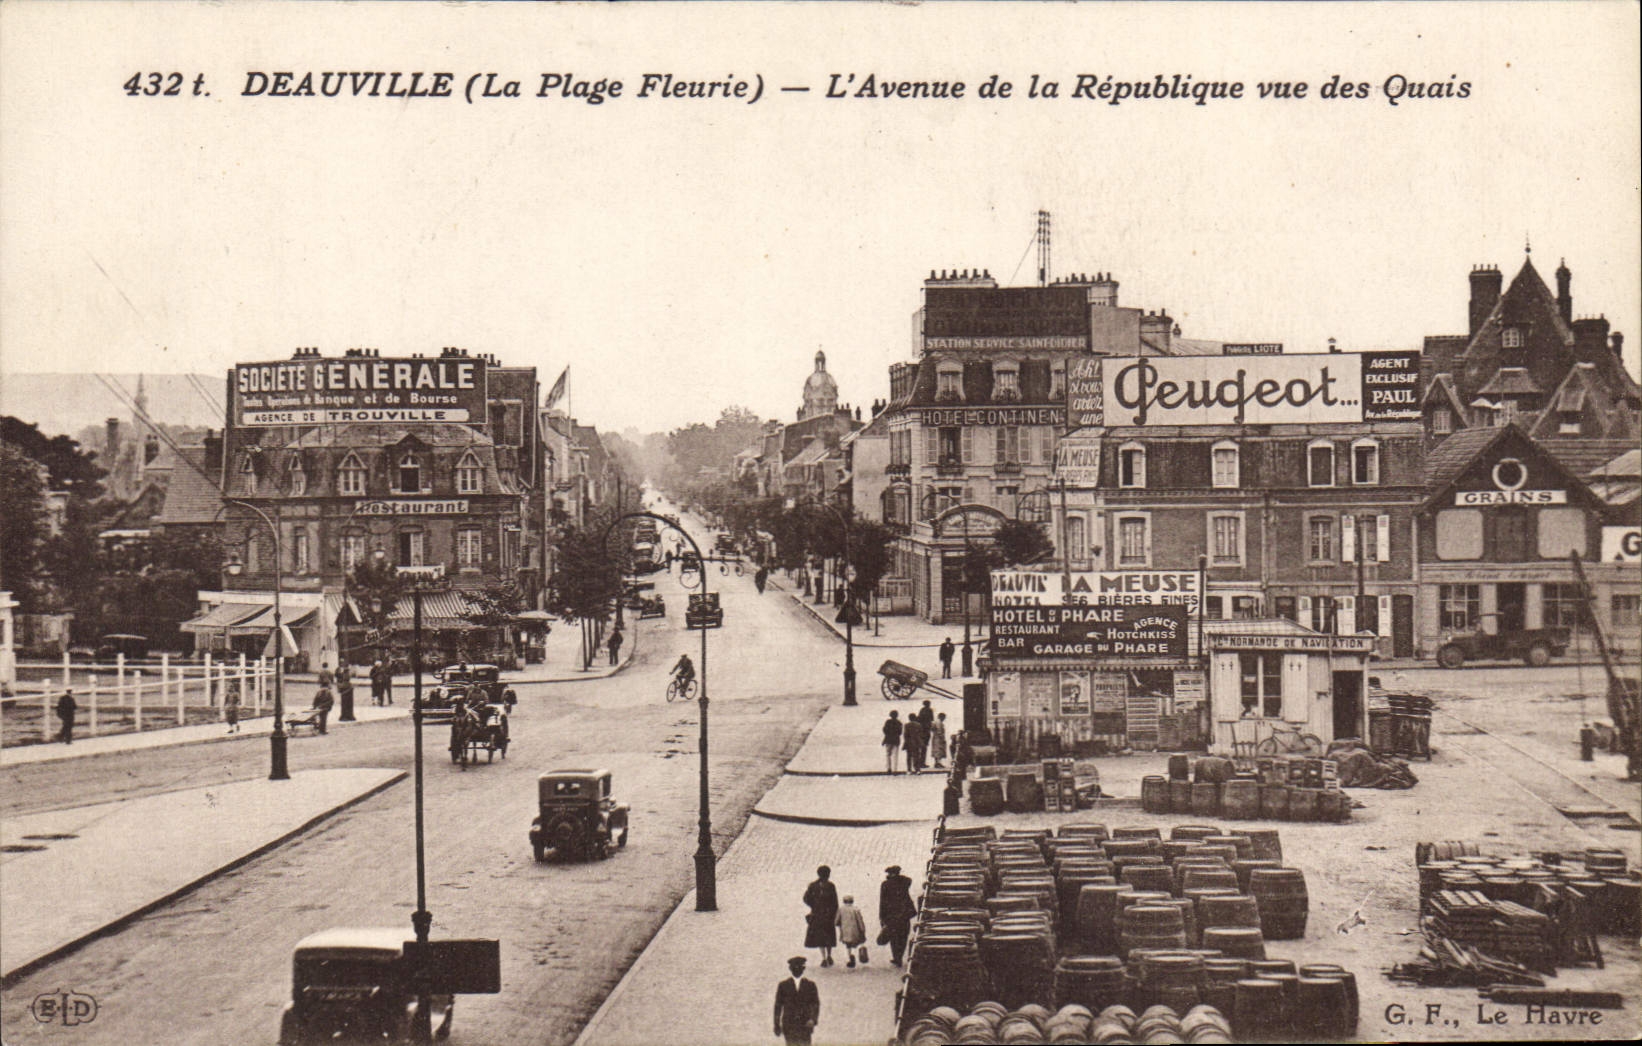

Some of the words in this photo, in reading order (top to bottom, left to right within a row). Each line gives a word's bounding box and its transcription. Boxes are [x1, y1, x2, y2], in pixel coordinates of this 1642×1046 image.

[927, 337, 972, 348] STATION
[1370, 358, 1411, 369] AGENT
[1365, 373, 1419, 385] EXCLUSIF
[314, 393, 355, 407] Banque
[364, 393, 377, 404] et
[385, 392, 400, 404] de
[410, 392, 458, 404] Bourse
[1372, 390, 1417, 404] PAUL
[303, 412, 317, 421] DE
[328, 411, 446, 420] TROUVILLE
[922, 410, 968, 425] HOTEL
[1080, 412, 1103, 425] une
[1464, 491, 1553, 503] GRAINS
[360, 501, 467, 514] Restaurant
[1100, 574, 1195, 593] MEUSE
[1161, 594, 1198, 606] FINES
[993, 609, 1045, 623] HOTEL
[1061, 609, 1125, 623] PHARE
[995, 624, 1061, 635] RESTAURANT
[1133, 616, 1179, 632] AGENCE
[1107, 627, 1177, 640] HOTCHKISS
[998, 637, 1025, 648] BAR
[1033, 643, 1093, 654] GARAGE
[1097, 643, 1109, 652] DU
[1114, 641, 1169, 654] PHARE
[1230, 637, 1278, 648] NORMANDE
